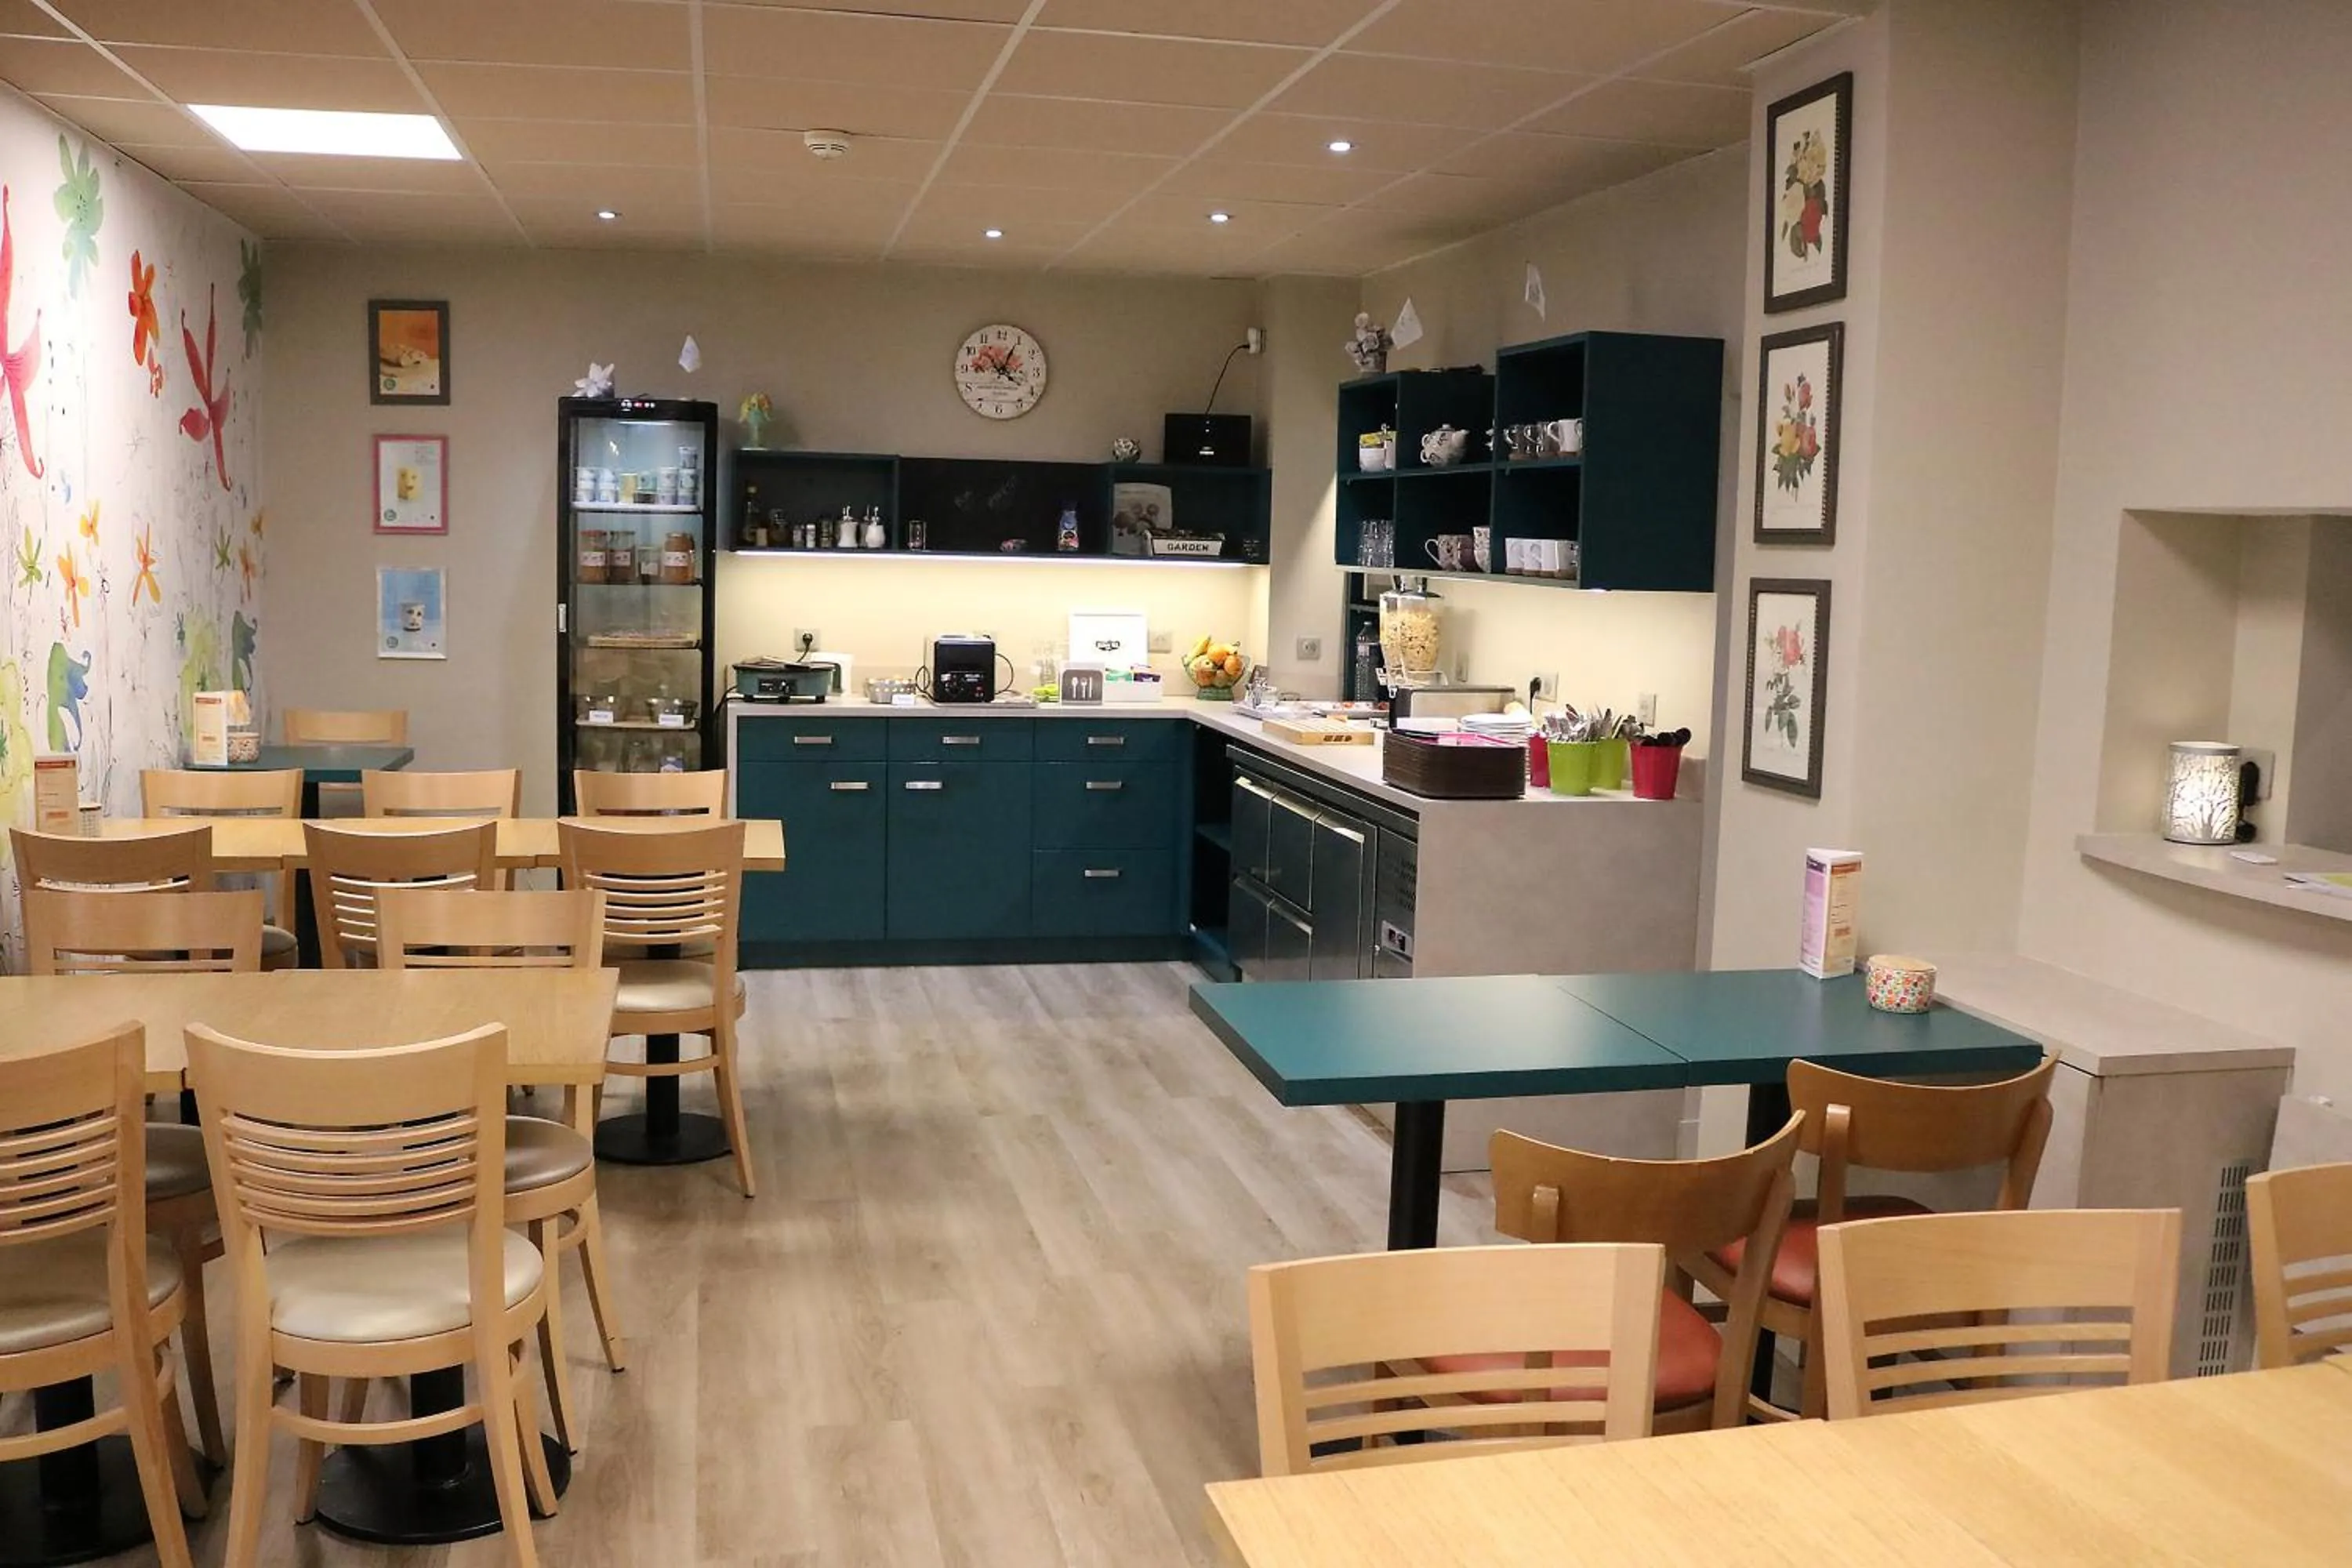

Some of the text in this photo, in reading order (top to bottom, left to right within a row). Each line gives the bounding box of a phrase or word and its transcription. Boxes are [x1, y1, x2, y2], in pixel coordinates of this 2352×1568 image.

[980, 333, 988, 344] 11
[966, 346, 976, 355] 10
[1028, 349, 1036, 360] 2
[960, 364, 968, 373] 9
[1033, 367, 1040, 377] 3
[995, 404, 1003, 414] 6
